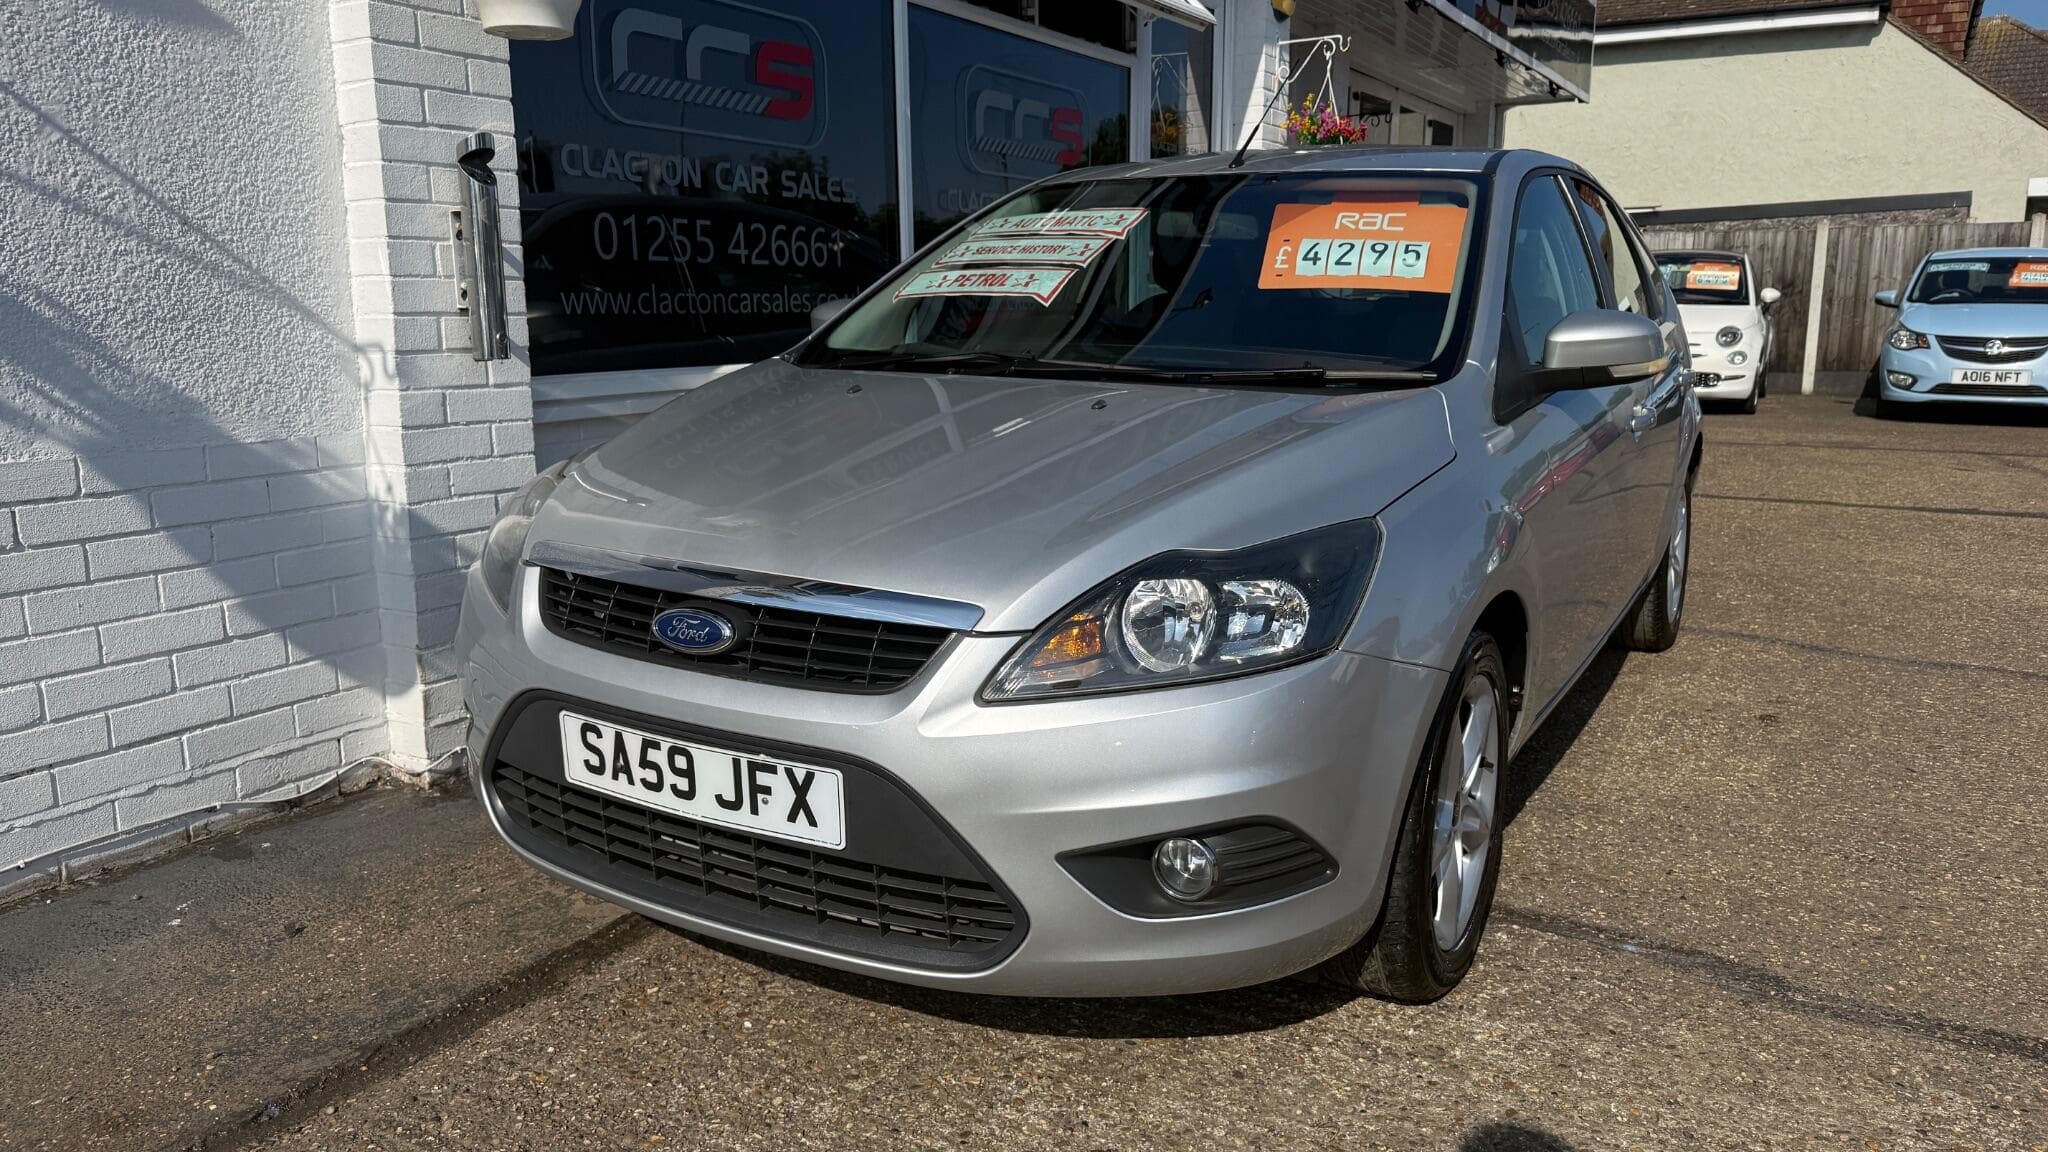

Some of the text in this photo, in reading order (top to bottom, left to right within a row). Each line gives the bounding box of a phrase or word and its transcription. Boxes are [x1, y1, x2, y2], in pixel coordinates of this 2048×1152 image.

[610, 7, 815, 121] CCS
[975, 88, 1085, 166] CCS
[560, 143, 857, 204] CLACTON CAR SALES
[593, 211, 844, 268] 01255 426661
[1012, 215, 1104, 228] AUTOMATIC
[972, 244, 1070, 256] SERVICE HISTORY
[947, 273, 1014, 287] PETROL
[1995, 371, 2022, 384] NFT
[667, 616, 710, 643] Ford
[580, 722, 819, 829] SA59 JFX
